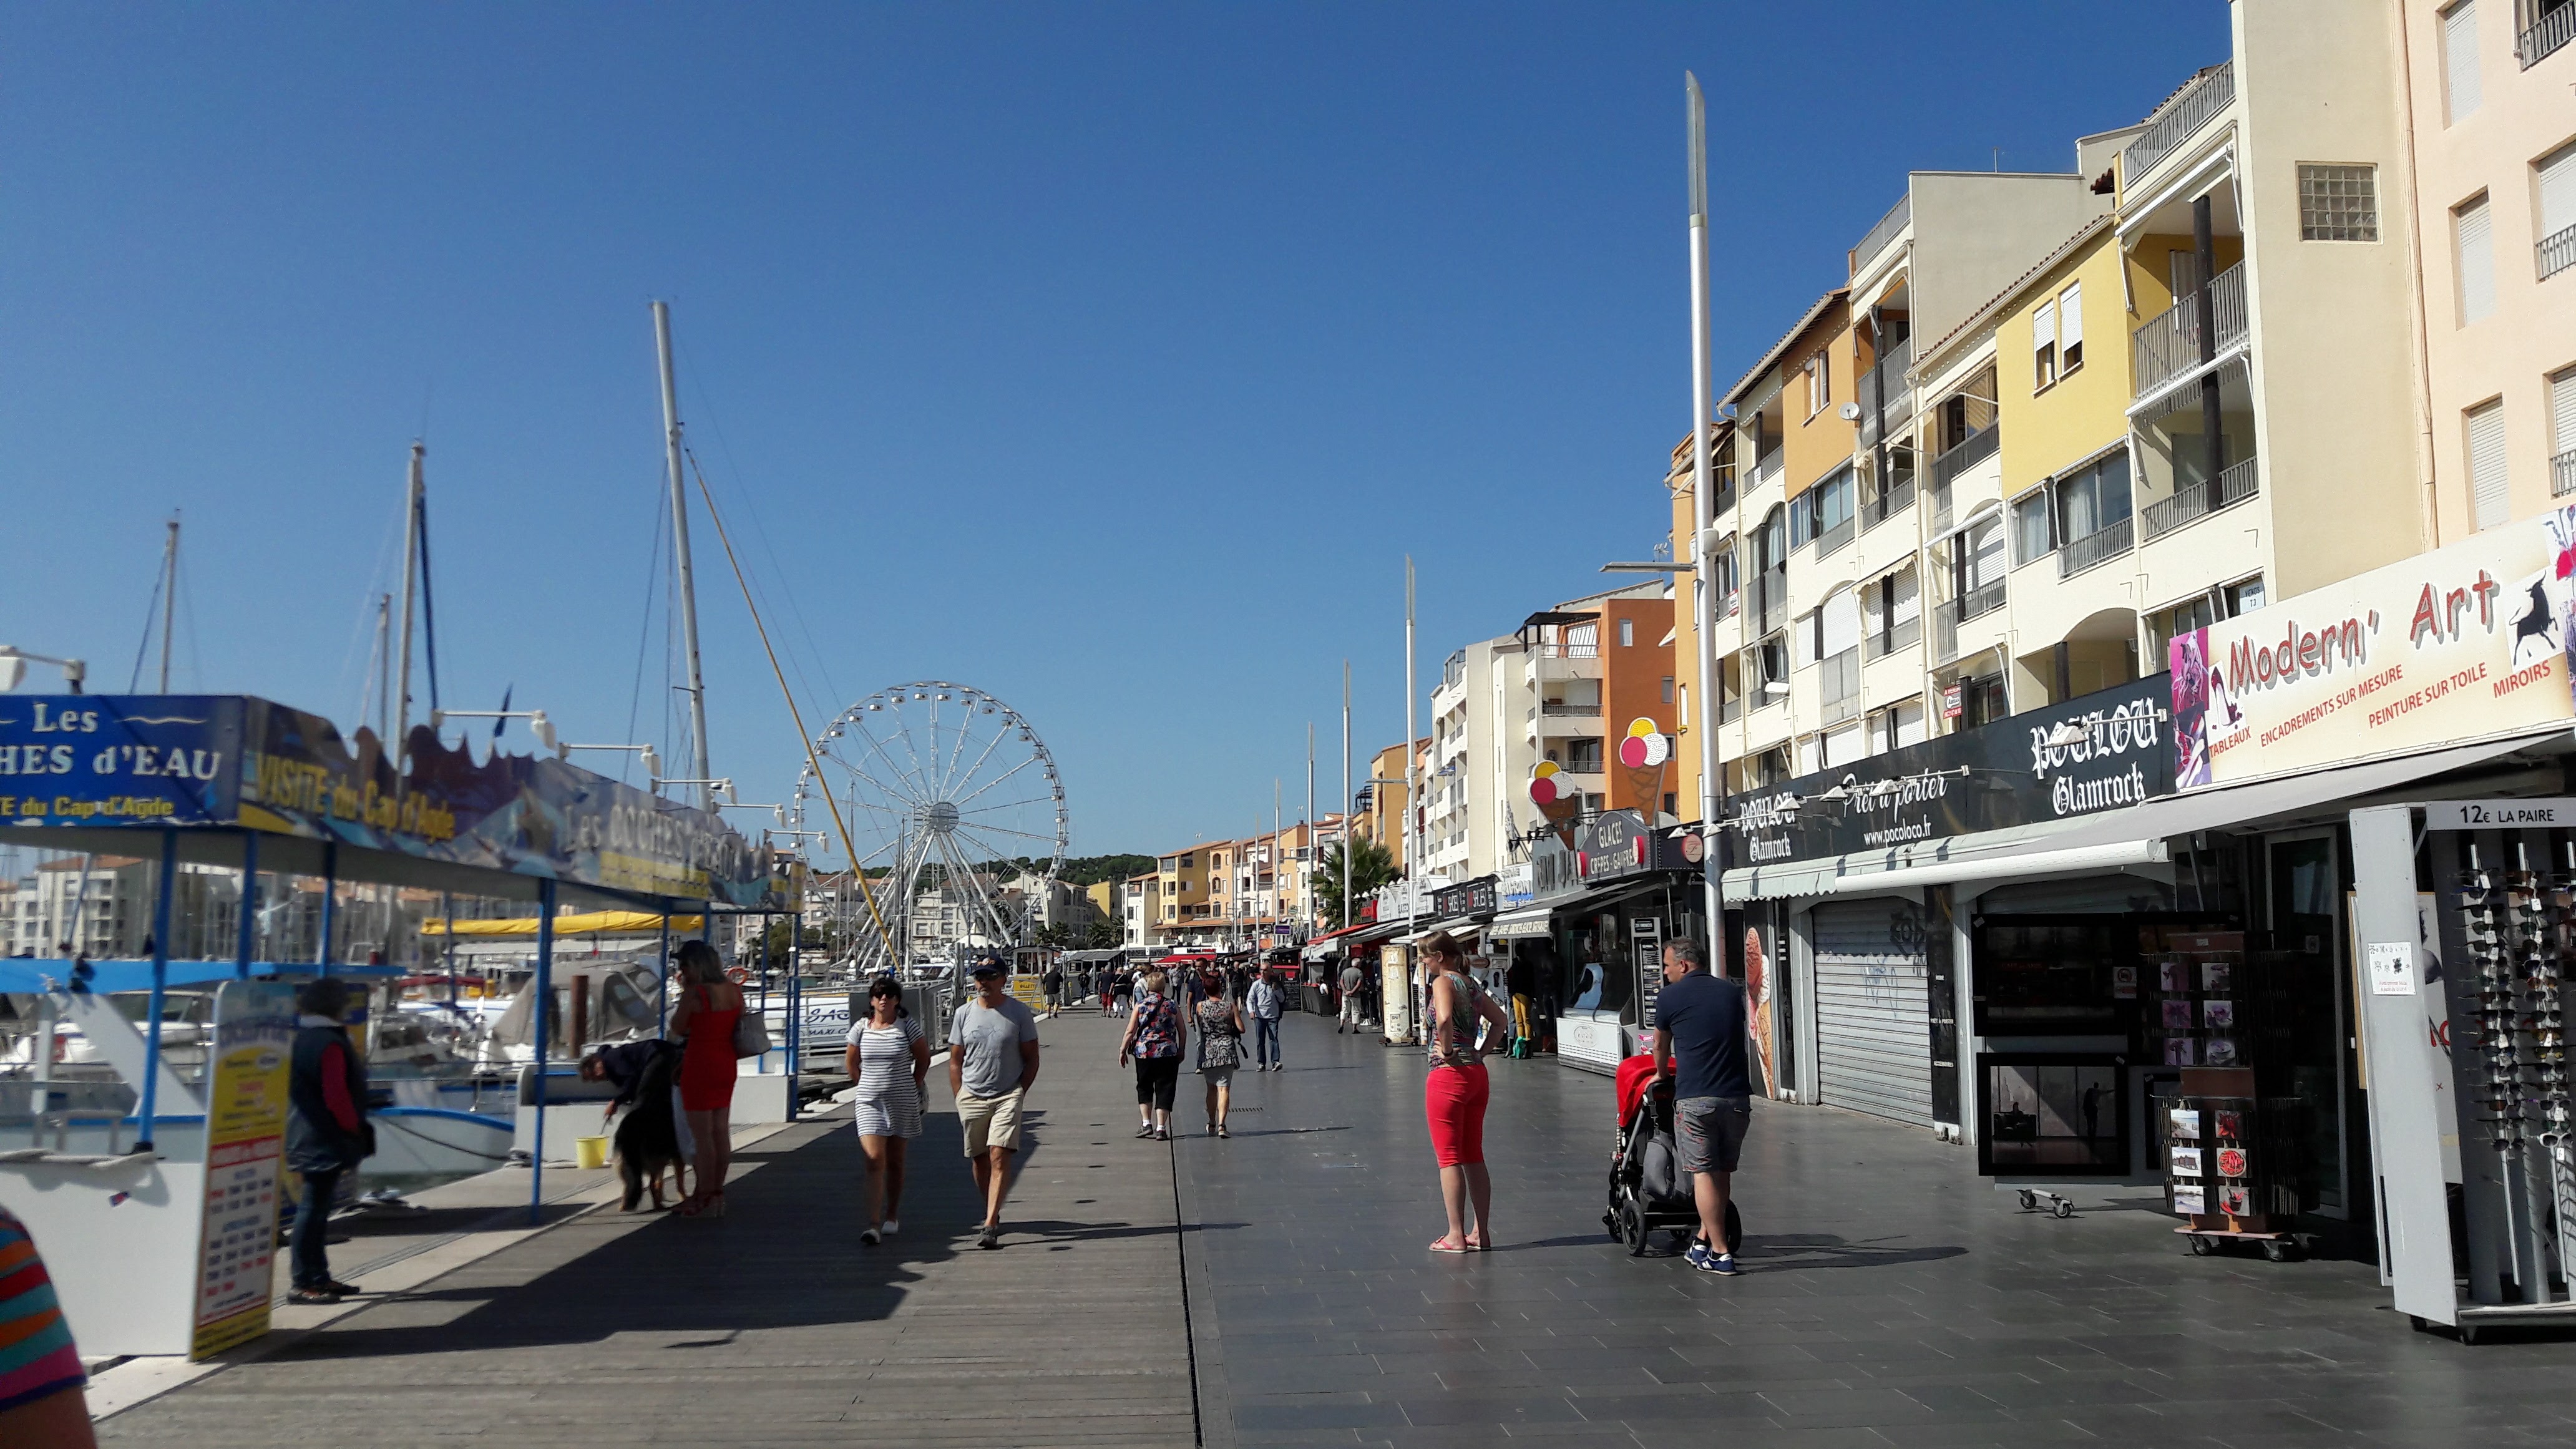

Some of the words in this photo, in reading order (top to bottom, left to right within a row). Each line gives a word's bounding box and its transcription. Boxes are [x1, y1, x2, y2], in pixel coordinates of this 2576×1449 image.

[2409, 569, 2496, 642] Art
[2368, 691, 2424, 729] PEINTURE
[2424, 680, 2449, 704] SUR
[2450, 661, 2487, 691] TOILE
[2492, 659, 2552, 700] MIROIRS
[32, 702, 99, 734] Les
[2260, 699, 2335, 748] ENCADREMENTS
[2336, 687, 2356, 710] SUR
[2358, 663, 2404, 699] MESURE
[2207, 725, 2252, 759] TABLEAUX
[92, 745, 222, 781] d'EAU
[256, 751, 329, 813] VISITE
[1894, 767, 1949, 824] porter
[2052, 760, 2147, 816] Glamrock
[20, 797, 48, 816] du
[54, 796, 95, 819] Cap
[99, 796, 175, 819] d'Agde
[2460, 805, 2491, 823] 12€
[2498, 810, 2515, 822] LA
[2519, 809, 2554, 822] PAIRE
[1598, 820, 1623, 849] GLACES
[1749, 830, 1792, 862] Glamrock
[1863, 813, 1932, 849] www.pocoloco.fr
